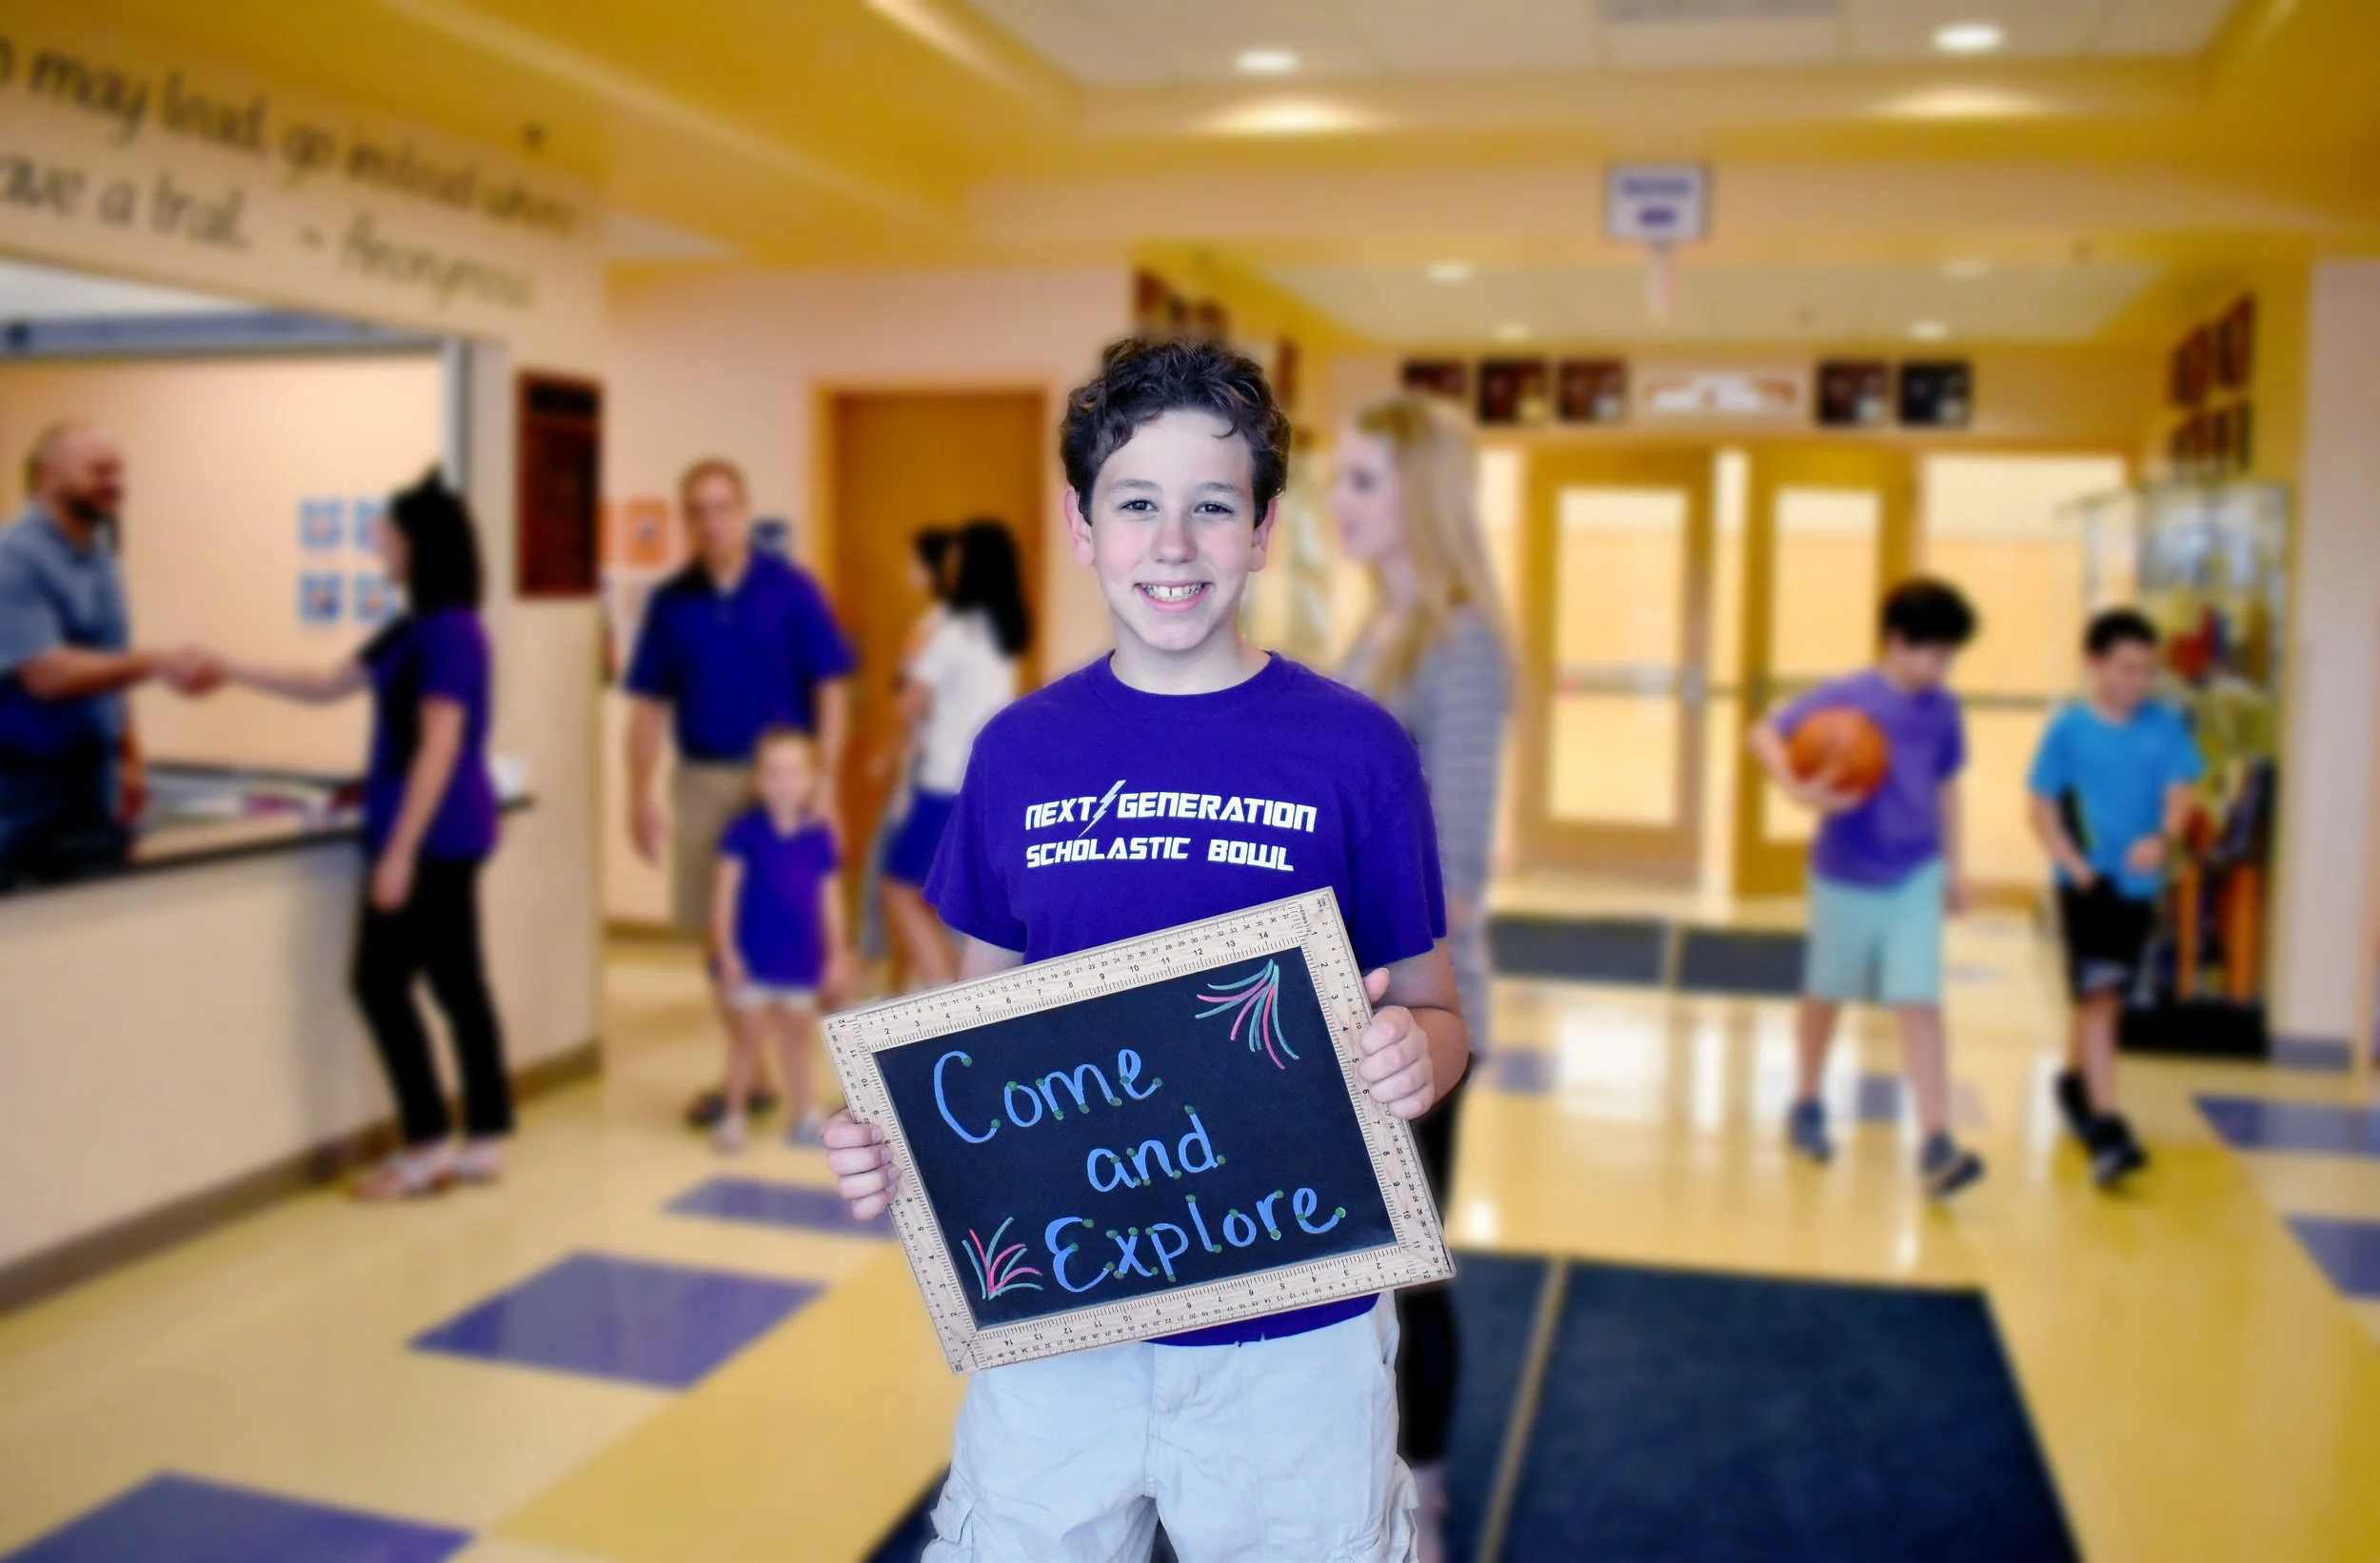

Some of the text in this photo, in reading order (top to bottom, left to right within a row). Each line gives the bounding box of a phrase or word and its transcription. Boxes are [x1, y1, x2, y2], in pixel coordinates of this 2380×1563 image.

[1025, 791, 1318, 833] NEXT GENERATION
[1026, 836, 1295, 872] SCHOLASTIC BOWL
[1036, 988, 1041, 997] 7
[1067, 980, 1074, 989] 8
[1129, 964, 1140, 973] 10
[1193, 947, 1203, 957] 12
[1225, 940, 1236, 948] 13
[1259, 931, 1269, 940] 14
[838, 1019, 846, 1028] 12
[849, 1049, 858, 1058] 11
[861, 1078, 869, 1088] 10
[932, 1048, 1163, 1144] Come
[1086, 1104, 1226, 1192] and
[1044, 1186, 1347, 1295] Explore
[1402, 1210, 1412, 1219] 10
[1413, 1240, 1421, 1249] 11
[1422, 1270, 1432, 1279] 12
[1034, 1333, 1043, 1341] 13
